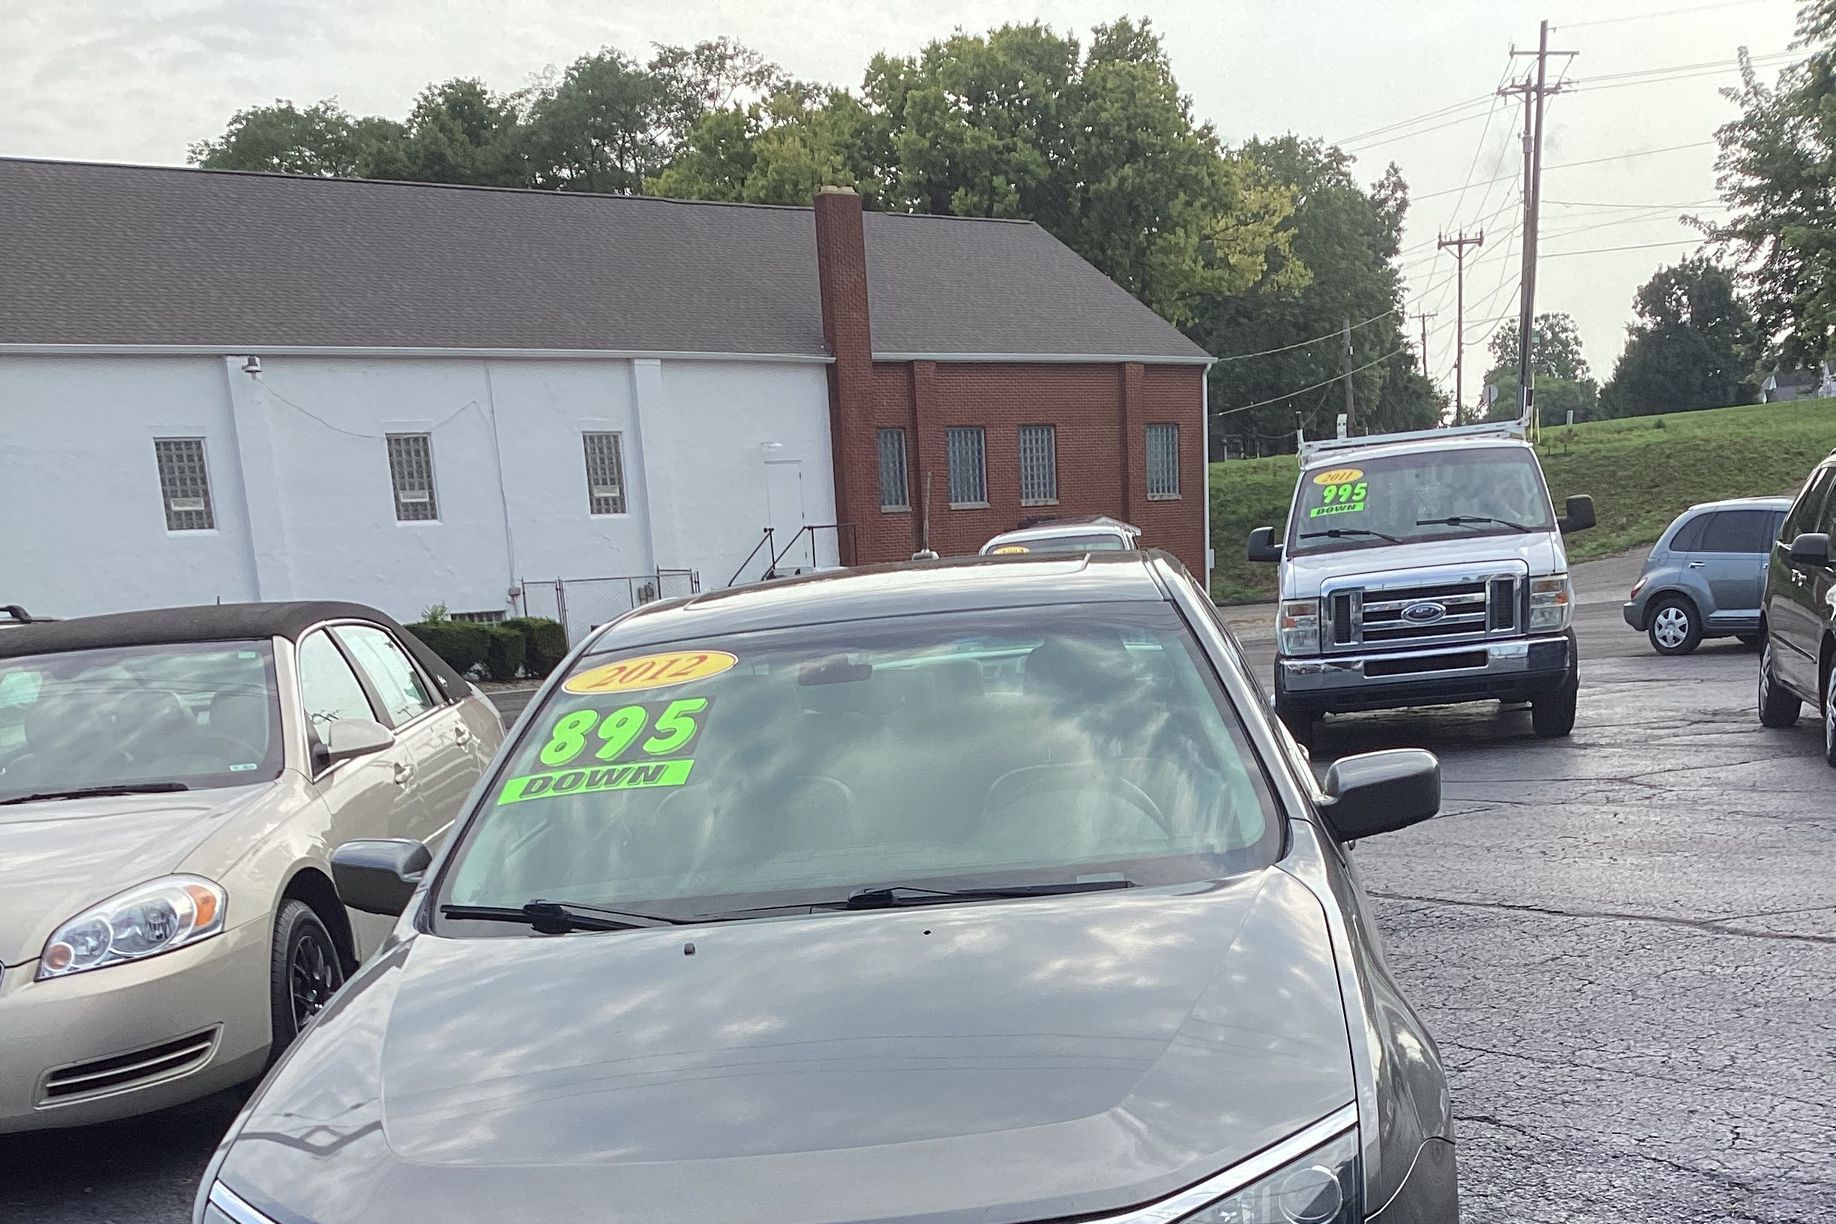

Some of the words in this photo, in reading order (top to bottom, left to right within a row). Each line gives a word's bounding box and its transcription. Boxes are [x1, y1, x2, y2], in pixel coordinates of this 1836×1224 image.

[1316, 504, 1356, 515] DOWN
[1323, 482, 1368, 504] 995
[586, 655, 709, 690] 2012
[540, 697, 709, 767] 895
[519, 762, 669, 799] DOWN
